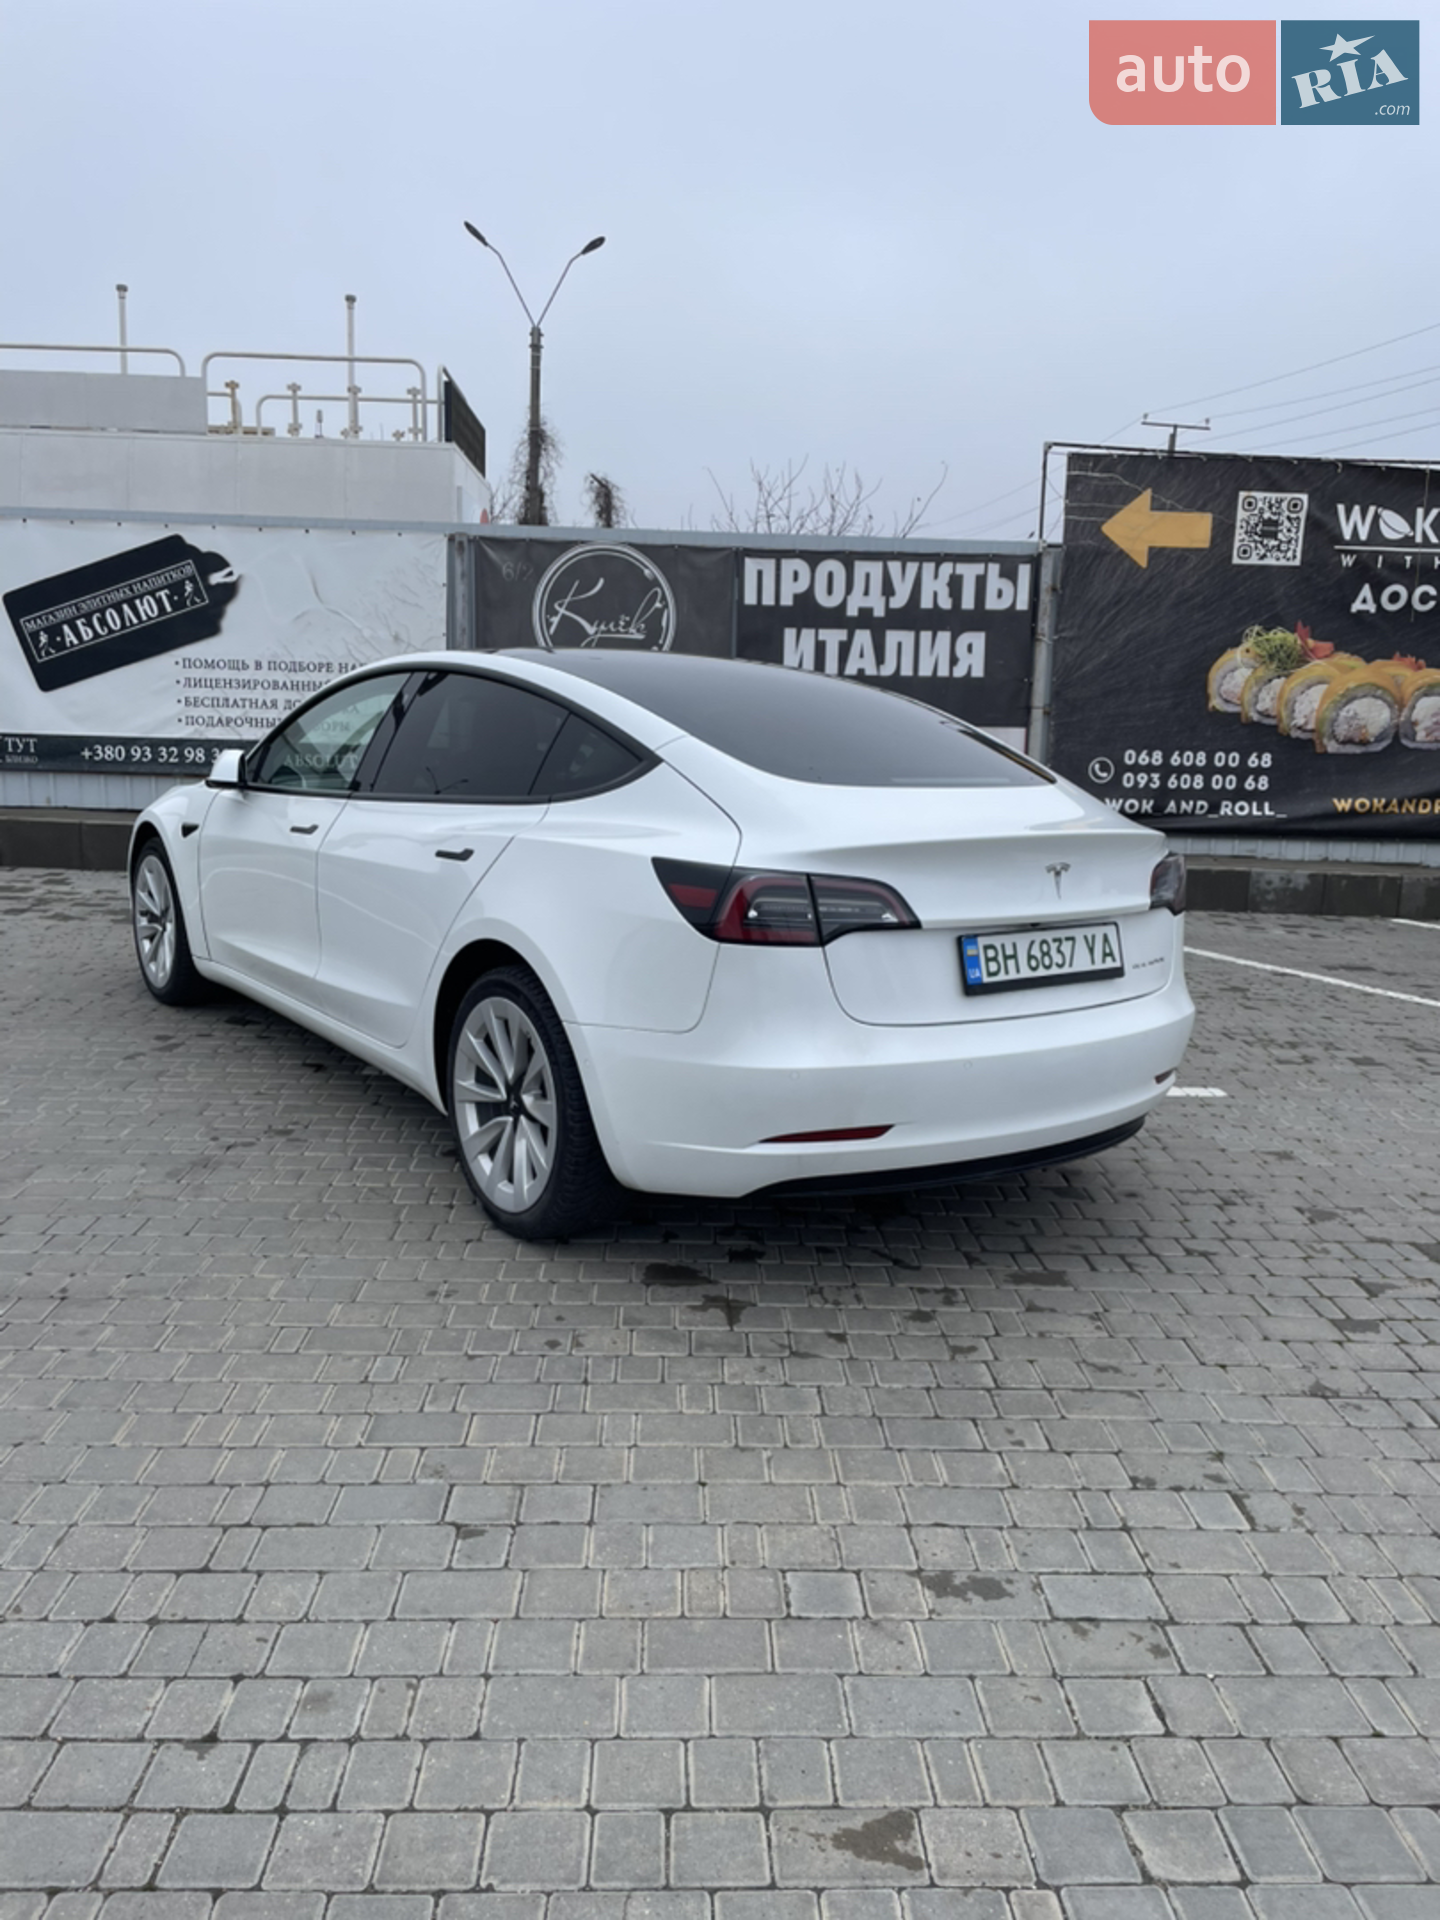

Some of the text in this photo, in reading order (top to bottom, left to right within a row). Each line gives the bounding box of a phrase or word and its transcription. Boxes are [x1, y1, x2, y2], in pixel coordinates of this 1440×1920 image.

[743, 557, 1031, 618] ПРОДУКТЫ
[24, 606, 78, 631] МАГАЗИН
[133, 564, 194, 594] НАПИТКОВ
[62, 589, 173, 648] АБСОЛЮТ
[783, 628, 986, 678] ИТАЛИЯ
[182, 658, 250, 672] ПОМОЩЬ
[254, 660, 263, 671] В
[268, 660, 334, 673] ПОДБОРЕ
[184, 696, 279, 710] БЕСПЛАТНАЯ
[185, 716, 283, 728] ПОДАРОЧНЫ
[81, 744, 126, 761] +380
[130, 745, 151, 762] 93
[158, 747, 179, 762] 32
[184, 747, 206, 763] 98
[1124, 749, 1272, 768] 068 608 00 68
[1122, 772, 1269, 791] 093 608 00 68
[982, 932, 1117, 979] BH 6837 YA
[968, 968, 981, 979] UA
